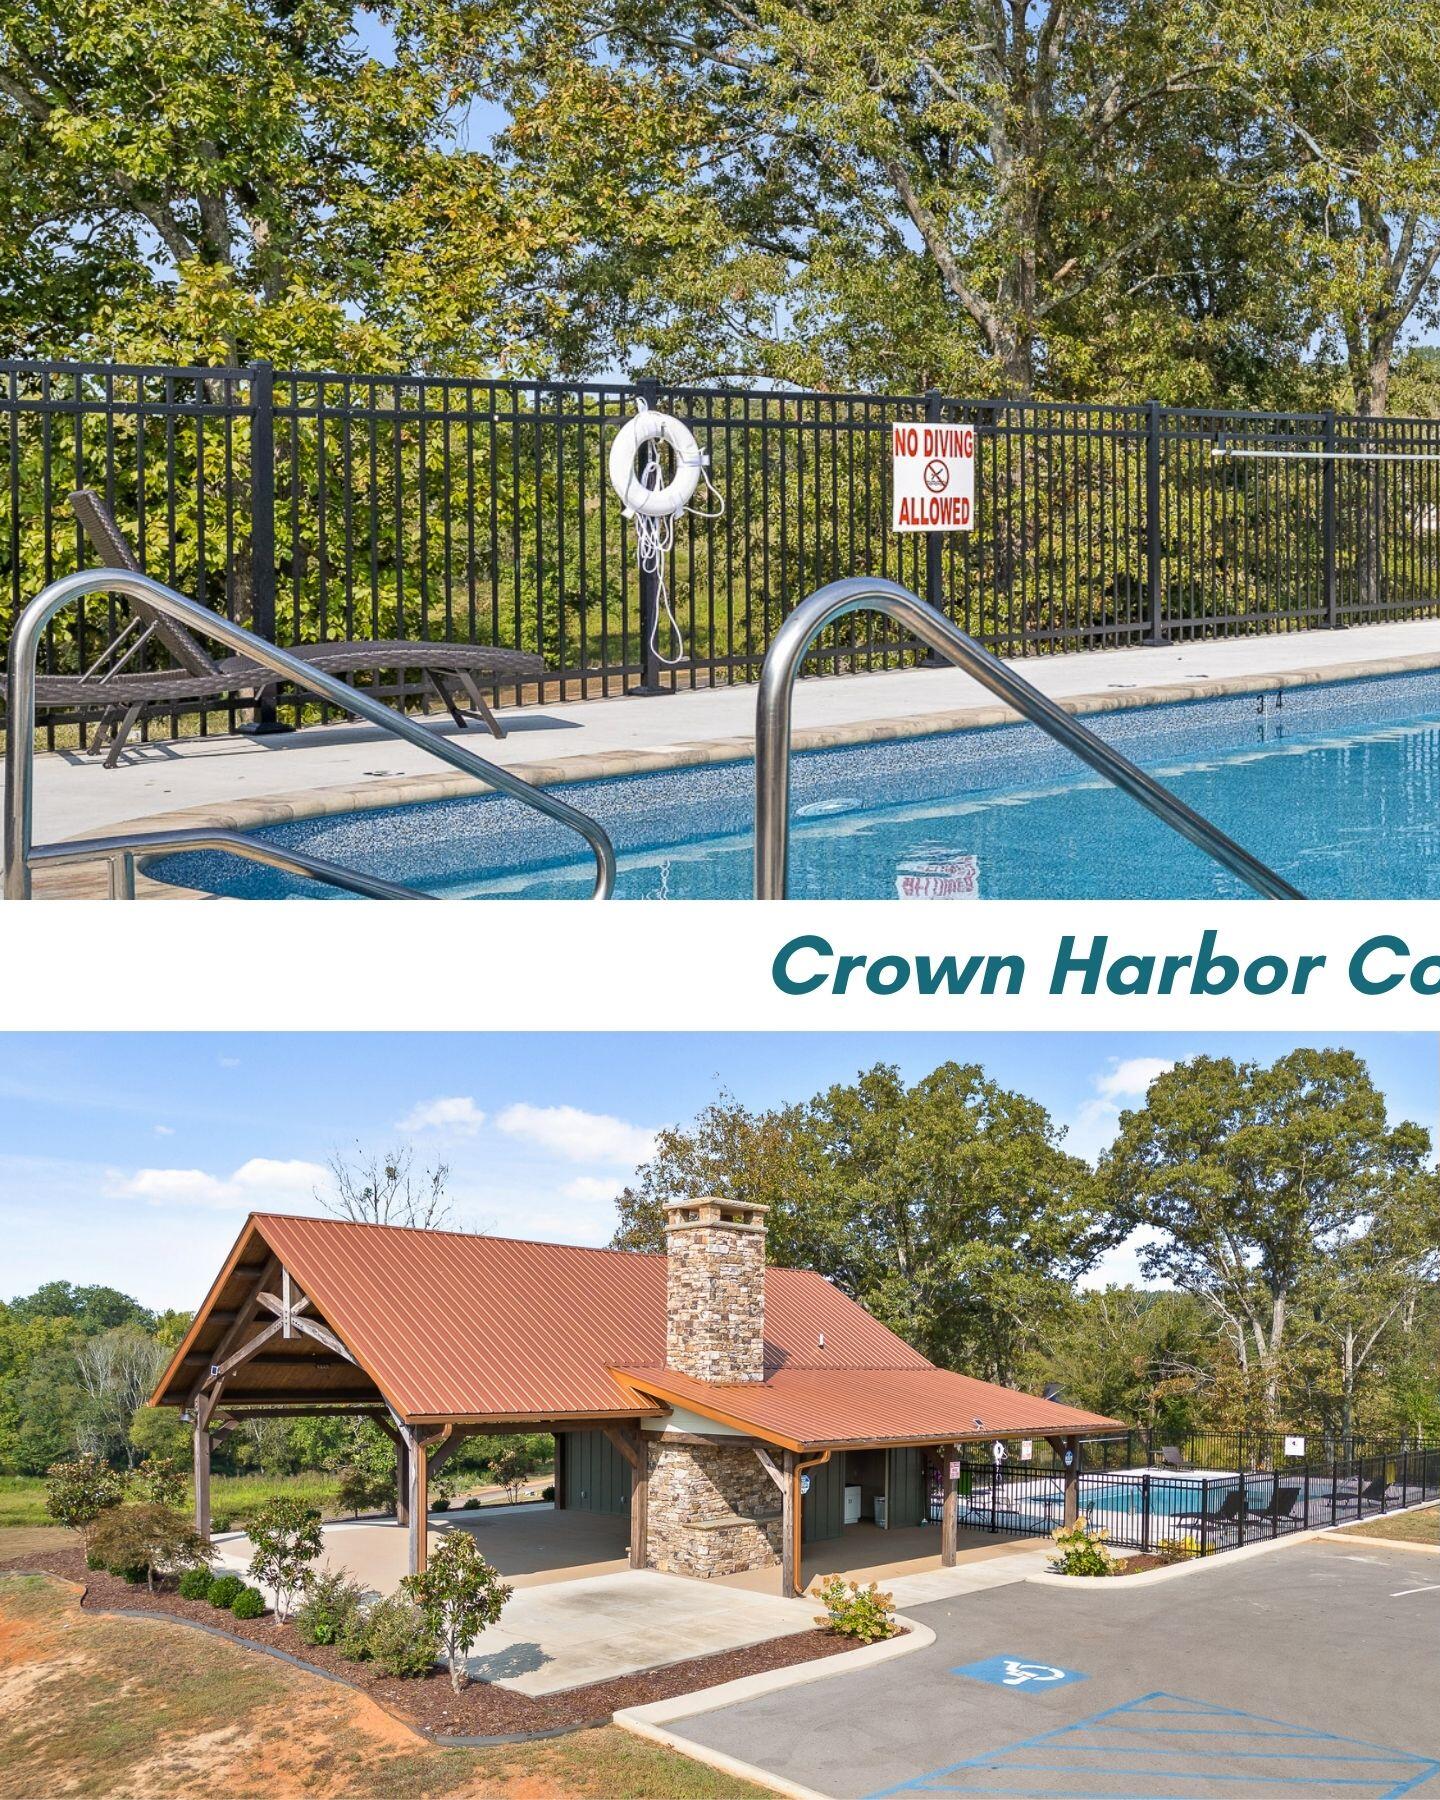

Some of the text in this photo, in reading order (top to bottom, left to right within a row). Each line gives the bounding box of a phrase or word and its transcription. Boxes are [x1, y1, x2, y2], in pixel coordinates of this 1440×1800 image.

[895, 428, 973, 458] NO DIVING
[899, 497, 970, 525] ALLOWED
